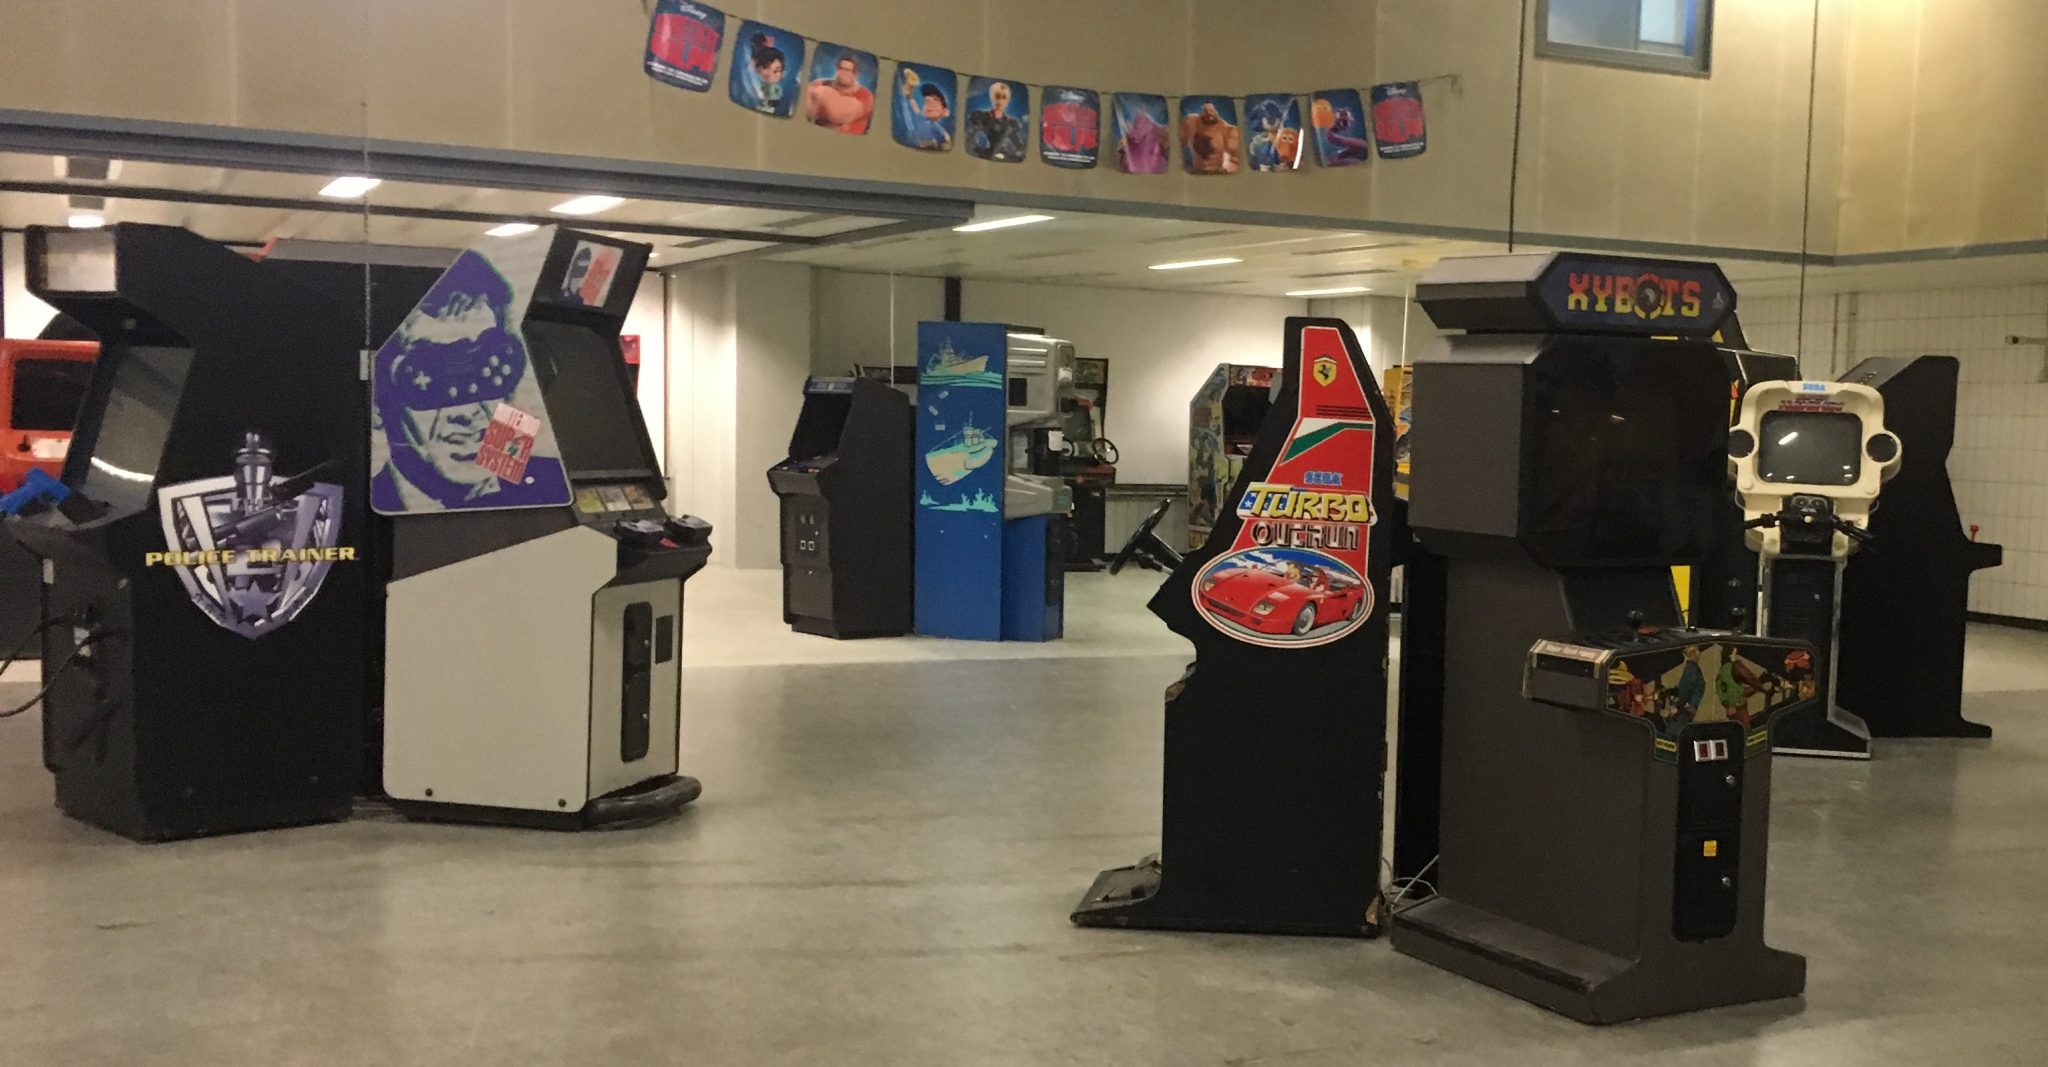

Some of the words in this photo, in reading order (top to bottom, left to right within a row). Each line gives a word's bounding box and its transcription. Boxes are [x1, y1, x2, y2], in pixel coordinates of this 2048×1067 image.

[1567, 271, 1702, 320] XYBOTS
[483, 419, 534, 463] SUPR
[475, 444, 525, 484] SYSTEM
[1303, 470, 1343, 486] SEGA
[1248, 485, 1371, 522] TURBO
[145, 550, 236, 567] POLICE
[246, 546, 356, 563] TRAINER
